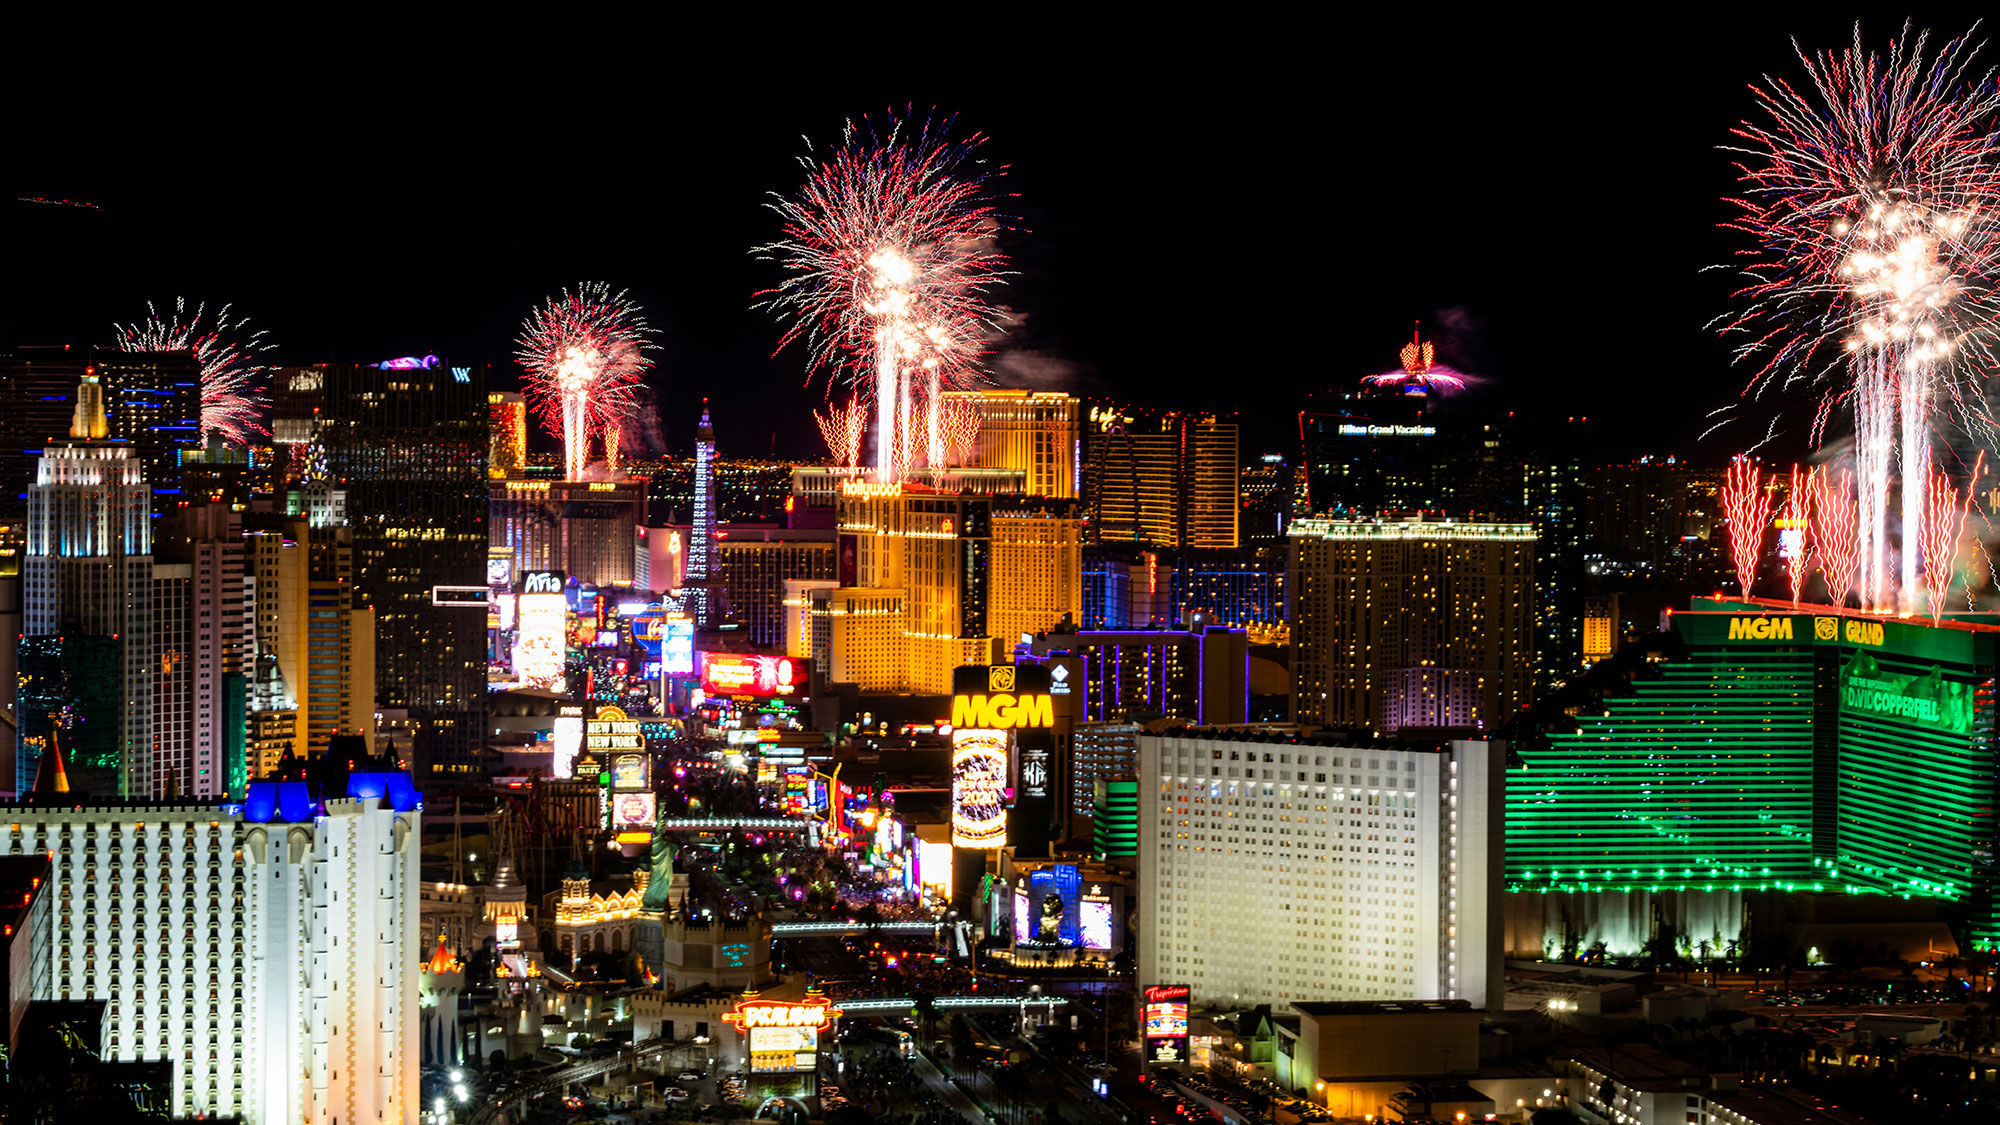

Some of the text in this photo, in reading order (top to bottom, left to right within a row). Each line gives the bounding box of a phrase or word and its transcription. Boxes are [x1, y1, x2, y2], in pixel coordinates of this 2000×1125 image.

[1339, 425, 1436, 436] Hilton Grand Vacations
[828, 467, 878, 475] VENTIAN
[506, 482, 551, 491] TREASURE
[843, 478, 902, 501] hollywood
[1728, 617, 1884, 646] MGM GRAND
[560, 706, 583, 716] PARK
[952, 694, 1054, 729] MGM
[588, 722, 638, 734] NEW YORK
[588, 735, 638, 747] NEW YORK
[962, 791, 997, 806] 2020
[1144, 985, 1189, 1003] Tropicana
